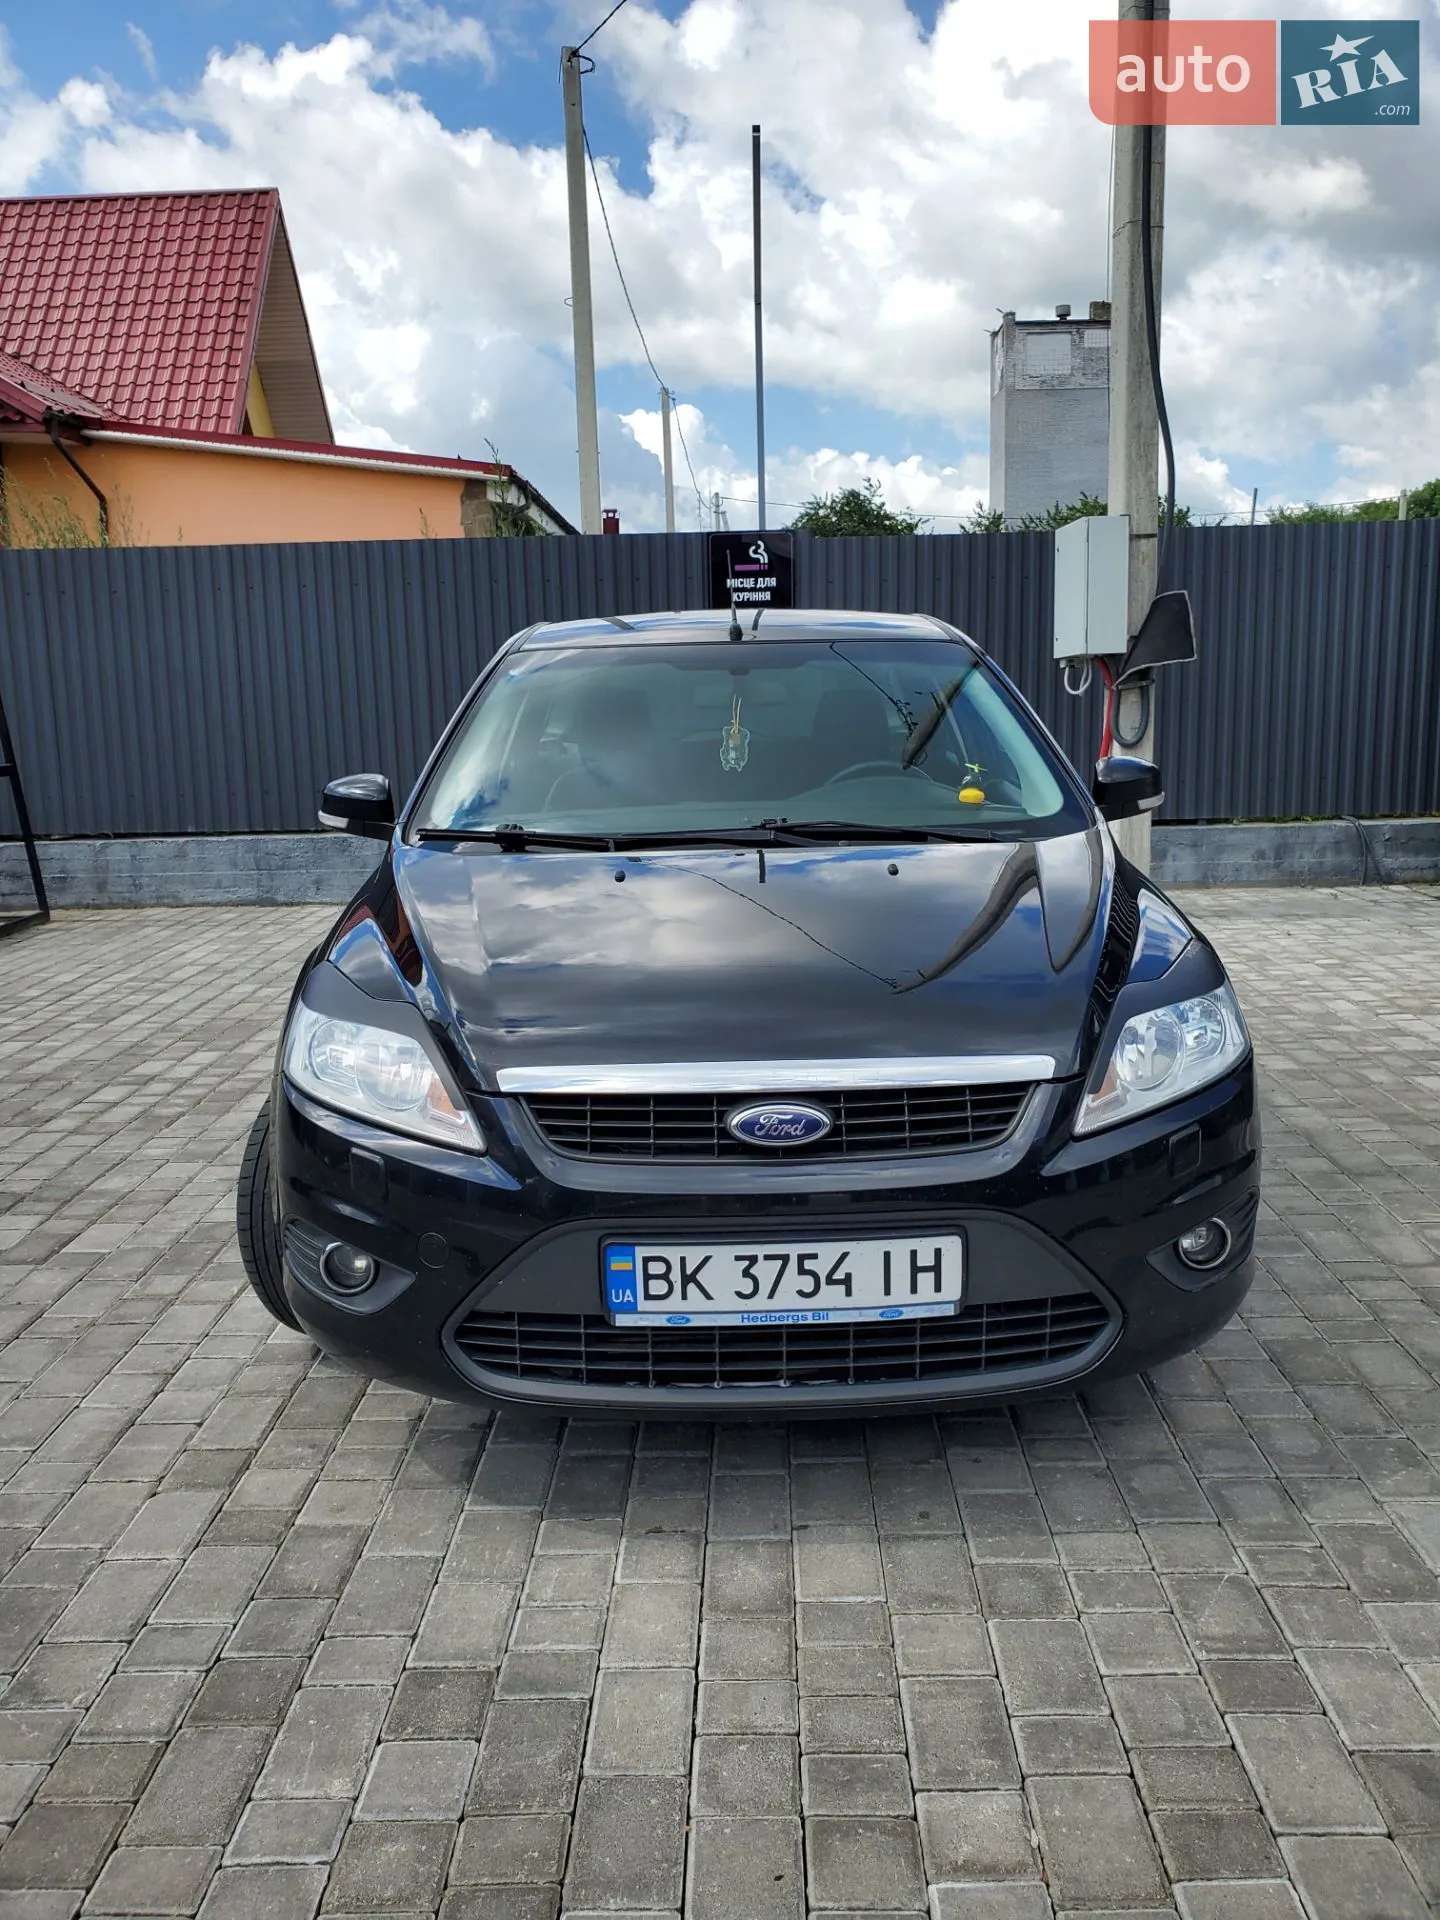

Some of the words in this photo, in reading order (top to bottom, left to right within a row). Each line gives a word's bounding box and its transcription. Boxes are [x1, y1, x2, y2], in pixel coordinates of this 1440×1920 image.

[756, 577, 777, 588] ДЛЯ
[732, 591, 771, 602] КУРІННЯ
[754, 1113, 806, 1136] Ford
[642, 1255, 714, 1301] BK
[734, 1251, 852, 1300] 3754
[883, 1247, 942, 1297] IH
[611, 1288, 634, 1303] UA
[741, 1312, 809, 1323] Hedbergs
[811, 1312, 829, 1321] Bil
